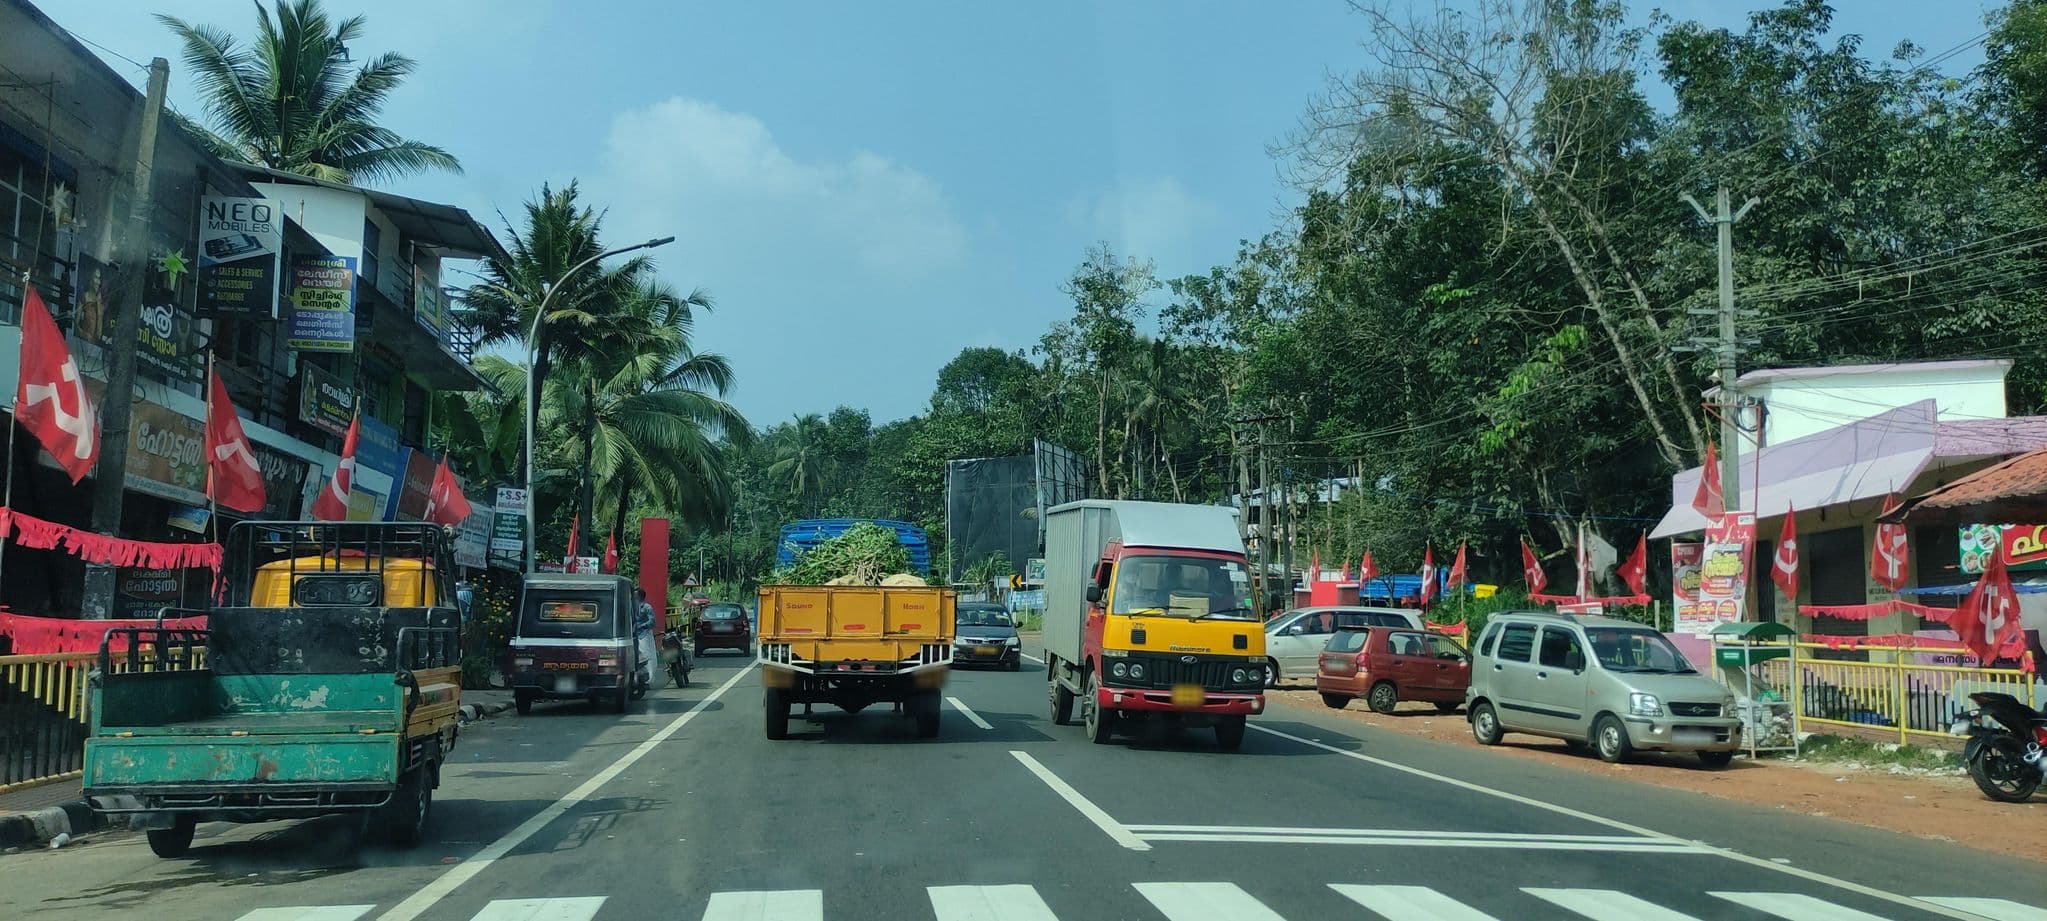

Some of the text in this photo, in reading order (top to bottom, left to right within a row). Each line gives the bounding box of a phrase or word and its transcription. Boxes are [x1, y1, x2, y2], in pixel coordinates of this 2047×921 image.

[209, 201, 271, 222] NEO
[208, 221, 270, 232] MOBILES
[219, 267, 234, 276] SALES
[242, 268, 264, 278] SERVICE
[218, 281, 253, 290] ACCESSORIES
